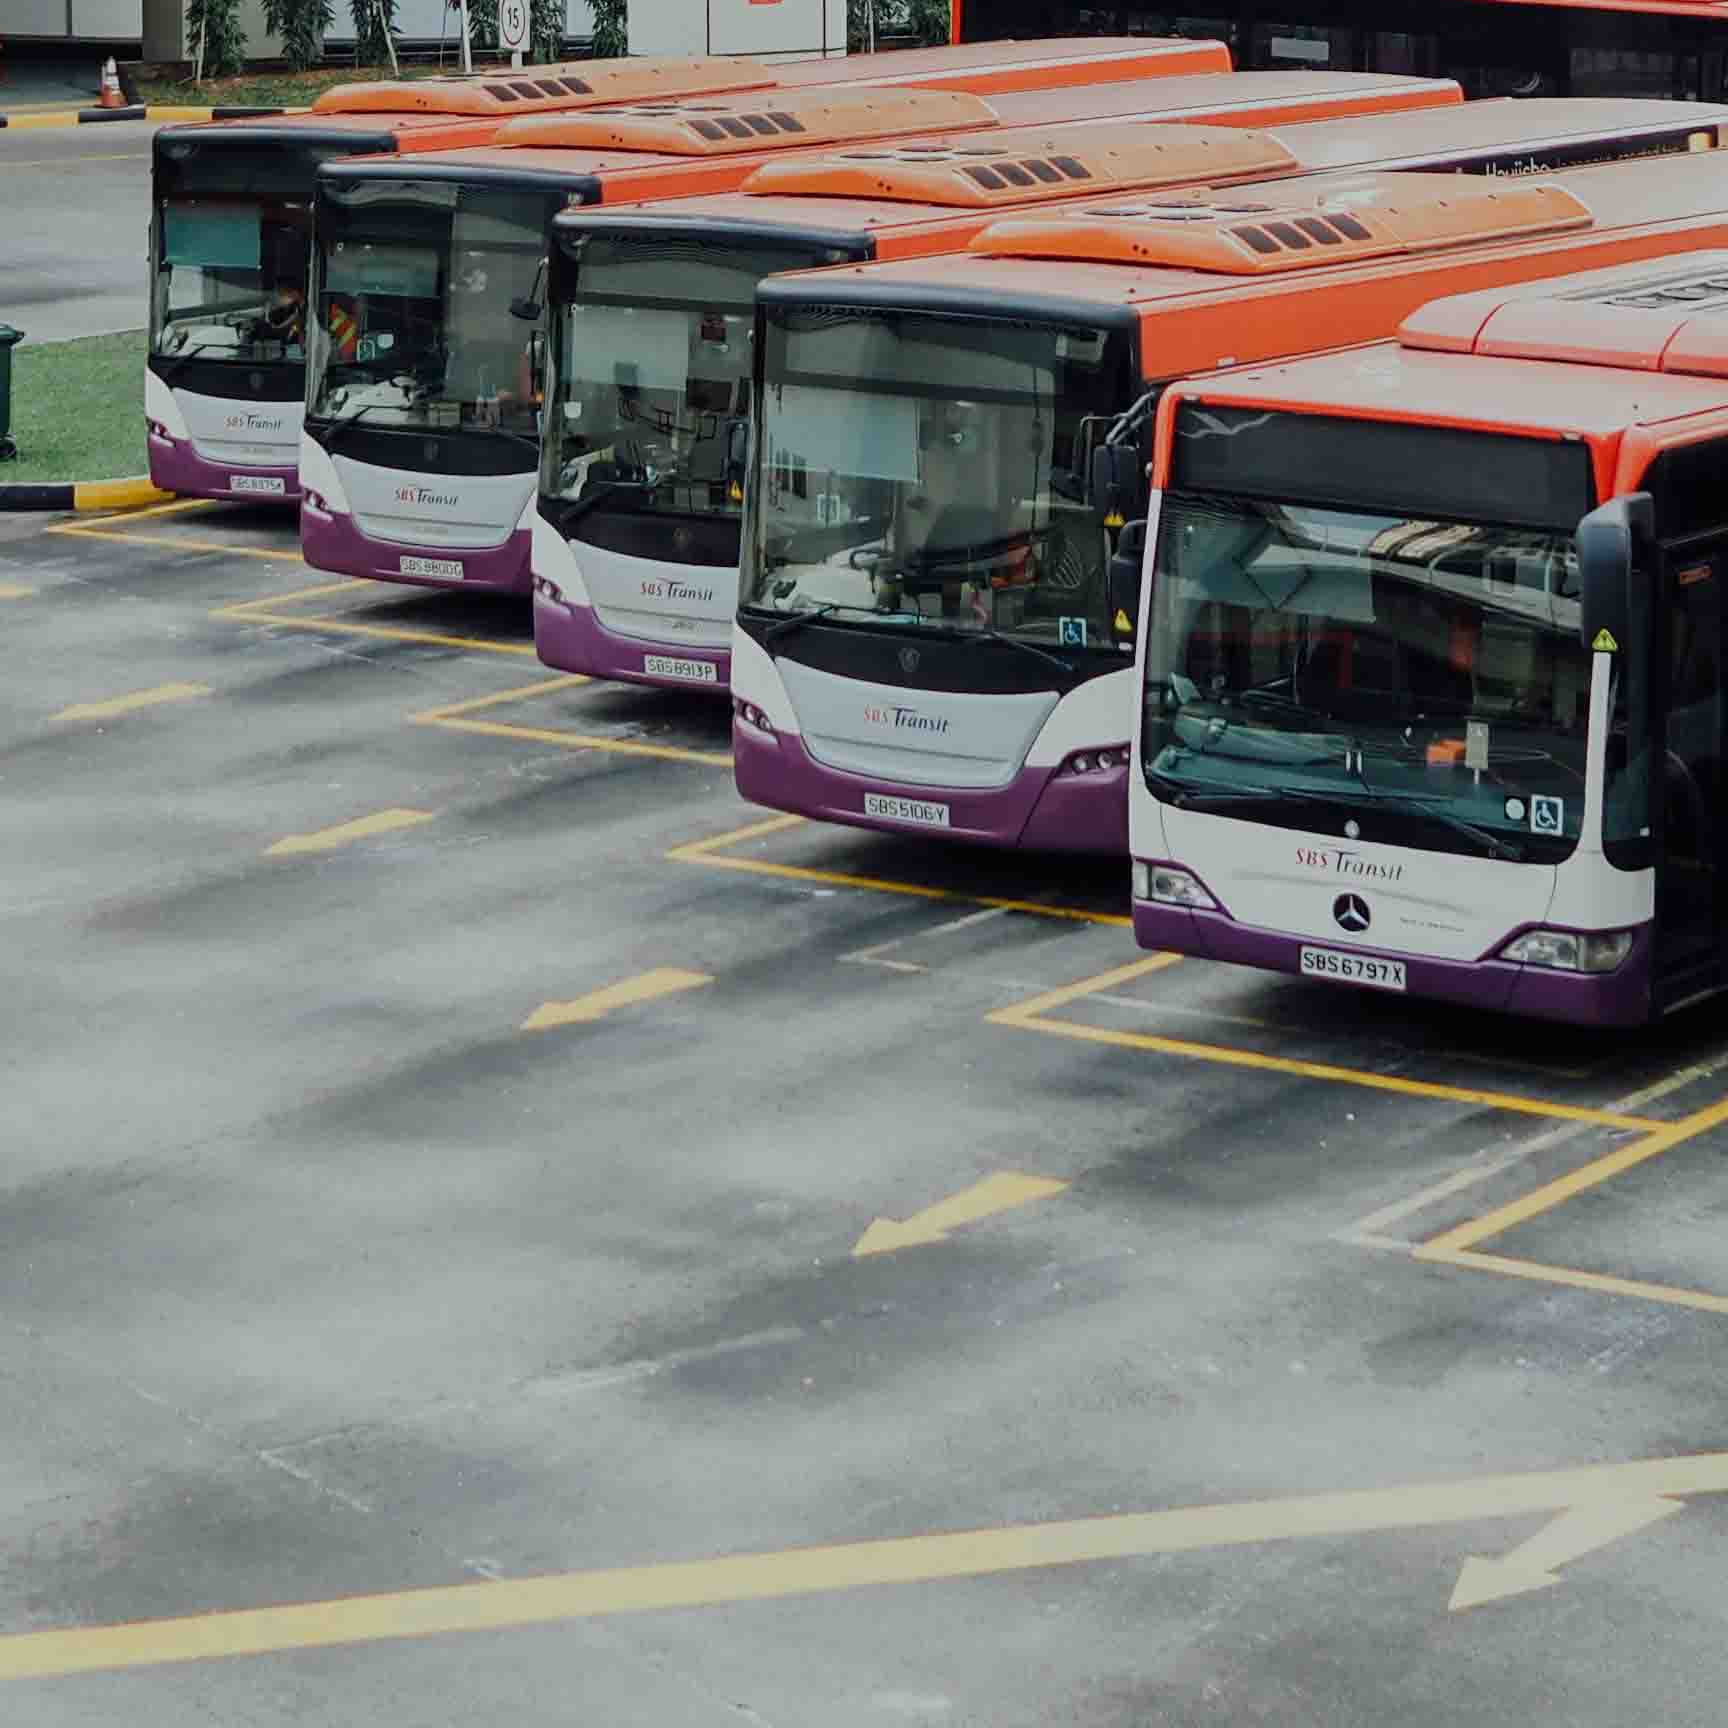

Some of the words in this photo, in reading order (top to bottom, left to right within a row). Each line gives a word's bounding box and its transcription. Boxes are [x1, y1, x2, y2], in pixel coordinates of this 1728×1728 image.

[508, 7, 519, 29] 15
[667, 581, 713, 601] Transit
[890, 708, 950, 733] Transit
[1295, 848, 1328, 867] SBS
[1329, 850, 1406, 881] Transit
[1303, 952, 1403, 985] SBS6797X
